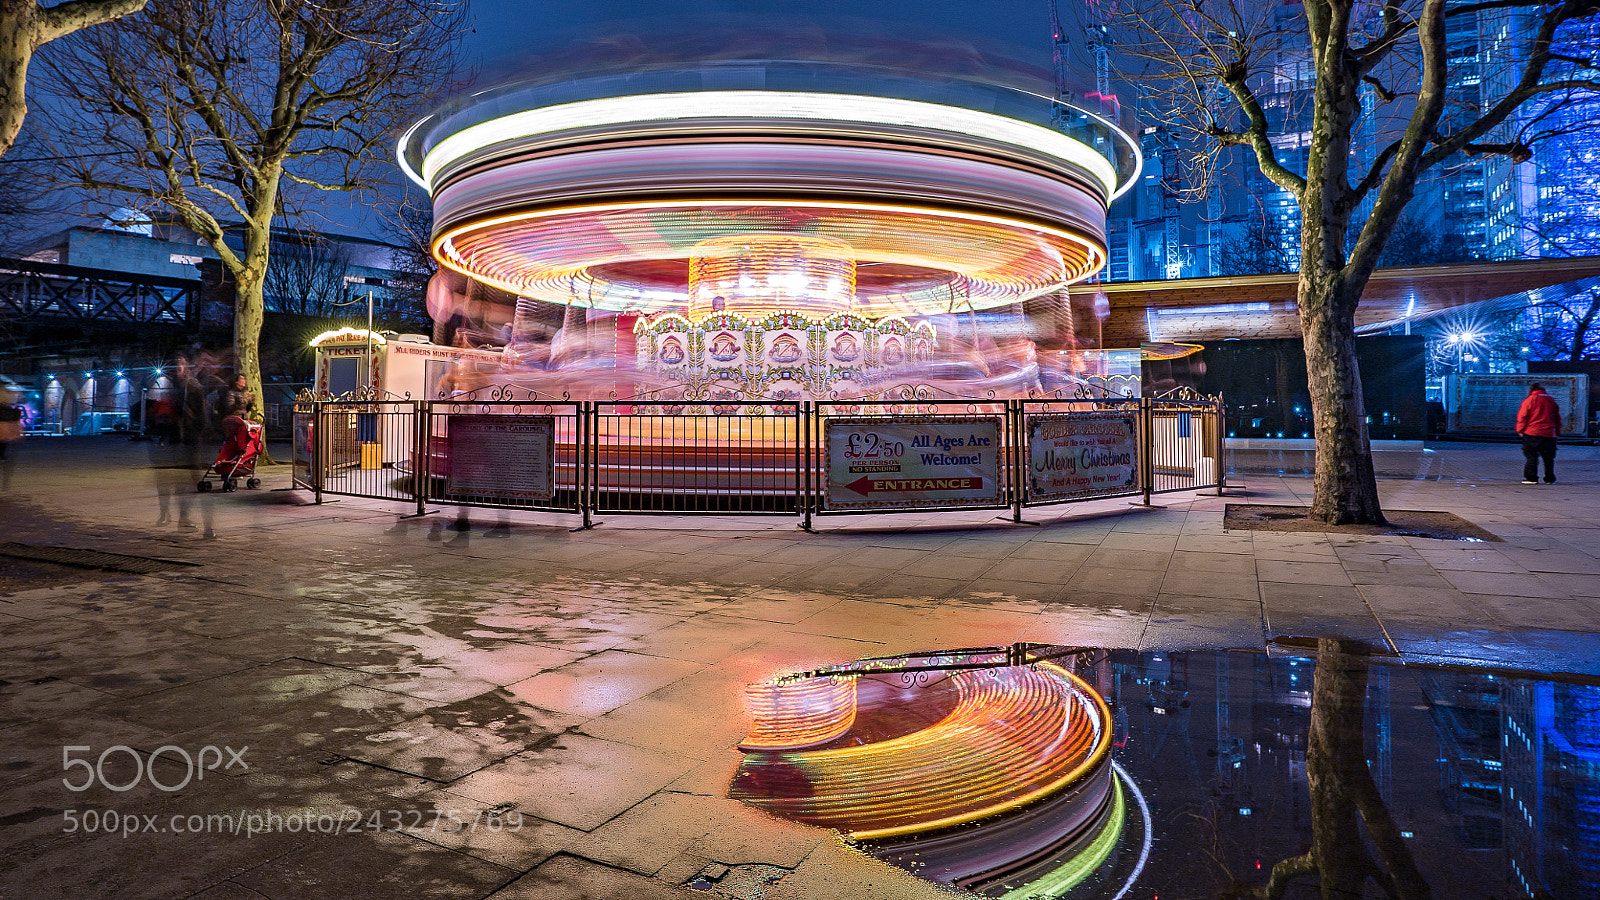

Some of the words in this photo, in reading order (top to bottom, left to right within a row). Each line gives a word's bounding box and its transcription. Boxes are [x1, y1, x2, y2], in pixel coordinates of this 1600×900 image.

[326, 346, 376, 356] TICKETS
[394, 346, 409, 354] ALL
[409, 347, 431, 356] RIDERS
[432, 350, 449, 358] MUST
[509, 425, 545, 433] CAROUSEL
[1041, 423, 1078, 440] GOLDEN
[1080, 422, 1125, 437] CAROUSEL
[911, 435, 930, 448] All
[934, 435, 964, 450] Ages
[967, 434, 991, 447] Are
[921, 453, 982, 466] Welcome!
[1035, 450, 1076, 475] Merry
[1081, 448, 1131, 470] Christmas
[873, 478, 971, 490] ENTRANCE
[1052, 479, 1065, 487] And
[1066, 478, 1071, 486] A
[1073, 476, 1092, 486] Happy
[1092, 475, 1105, 483] New
